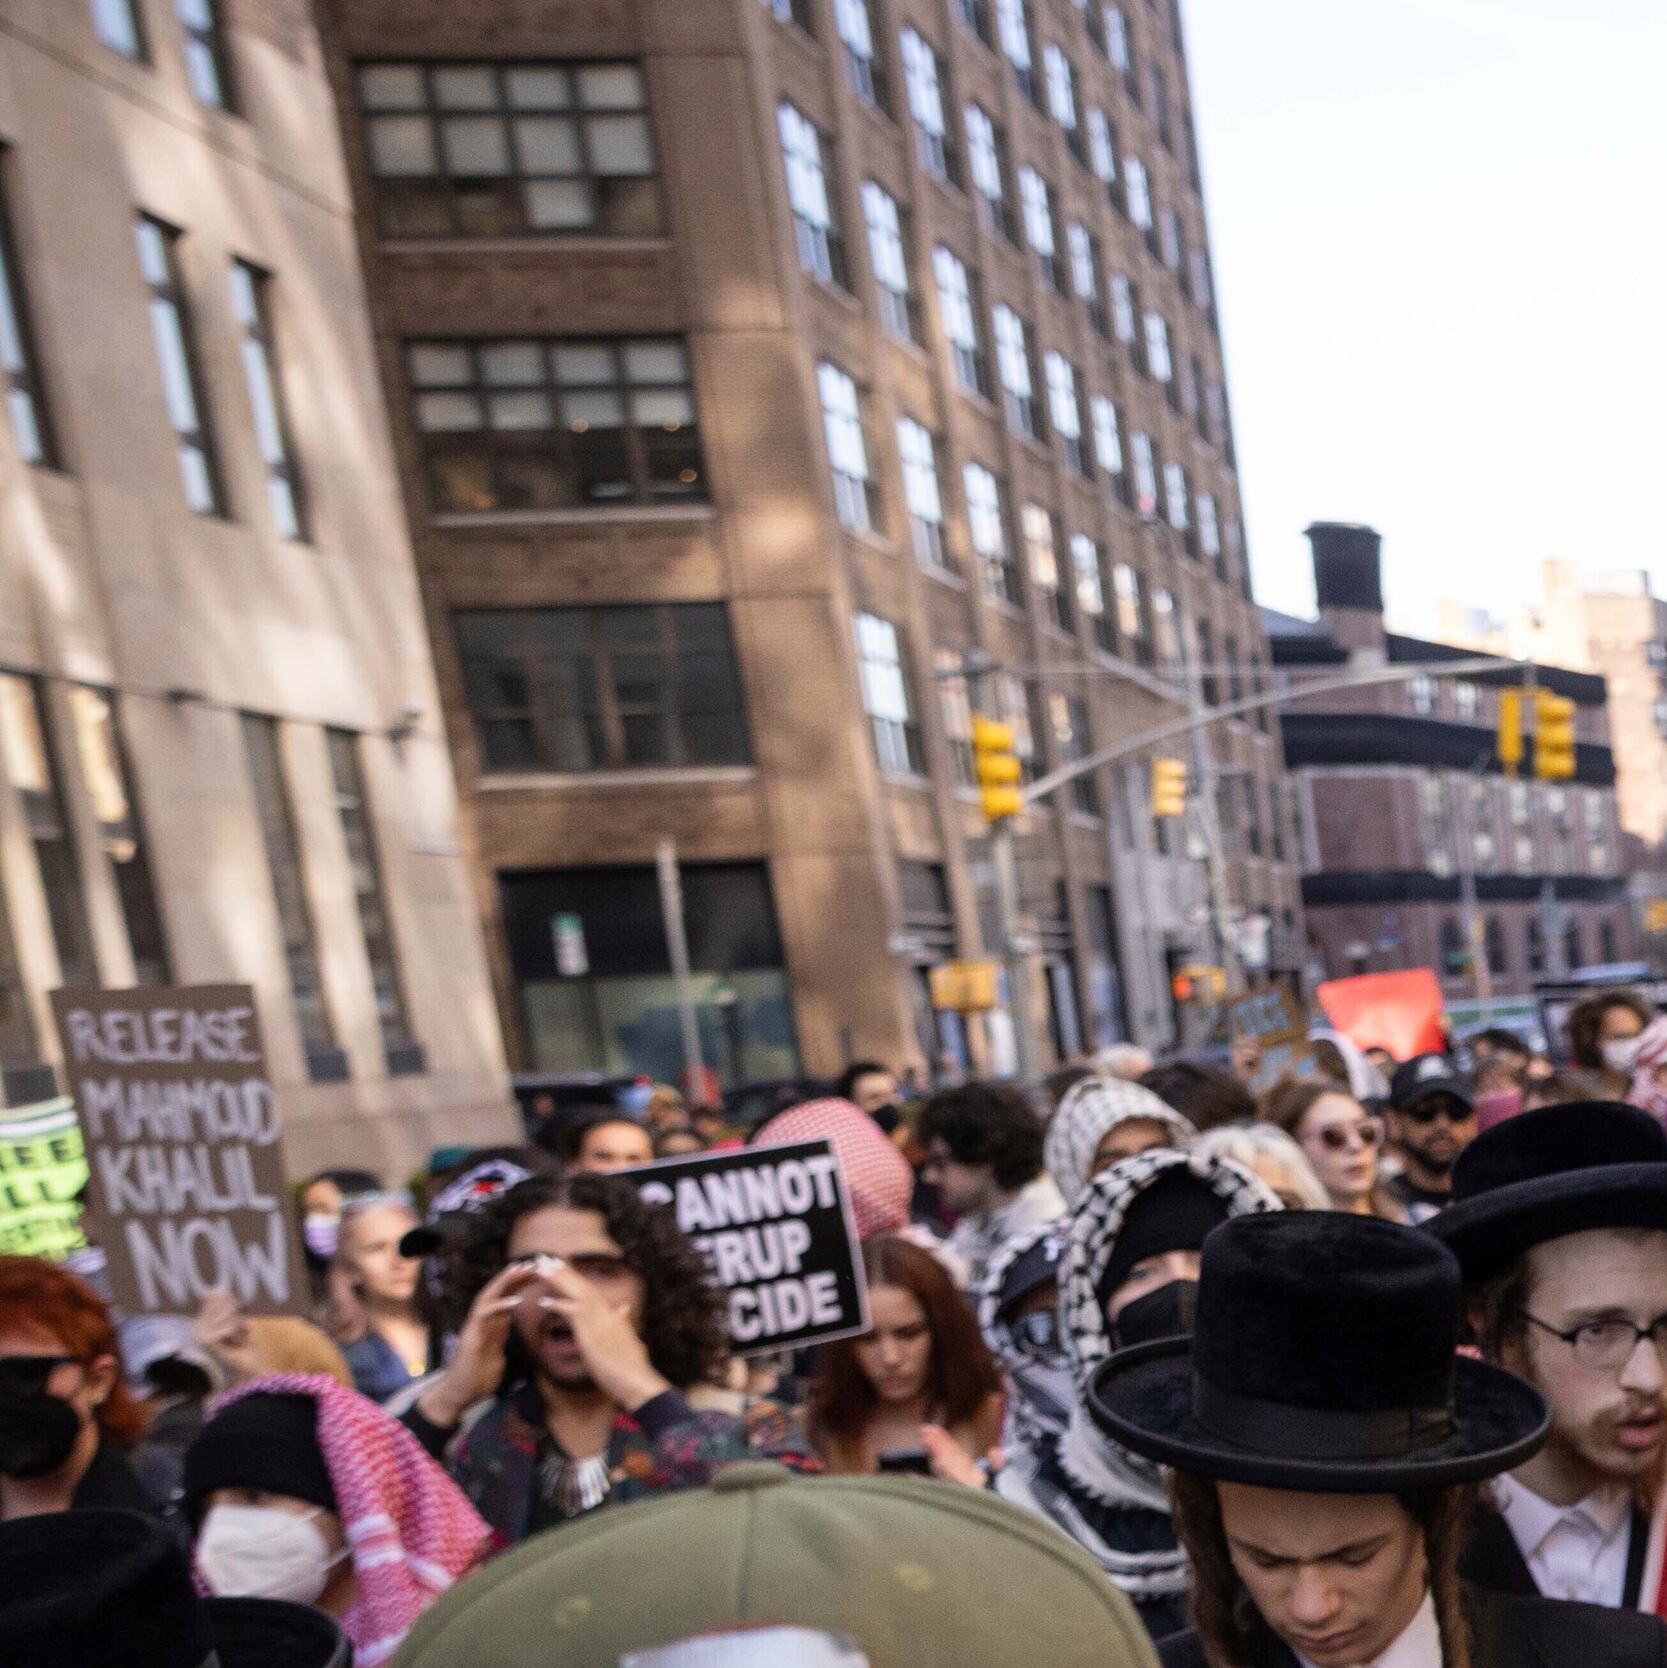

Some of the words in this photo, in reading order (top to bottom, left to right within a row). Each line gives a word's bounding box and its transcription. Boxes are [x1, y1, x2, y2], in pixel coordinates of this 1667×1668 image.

[66, 1007, 262, 1065] RELEASE
[81, 1076, 284, 1149] MAHMOUD
[97, 1144, 280, 1217] KHALIL
[124, 1210, 292, 1313] NOW
[728, 1268, 843, 1342] CIDE
